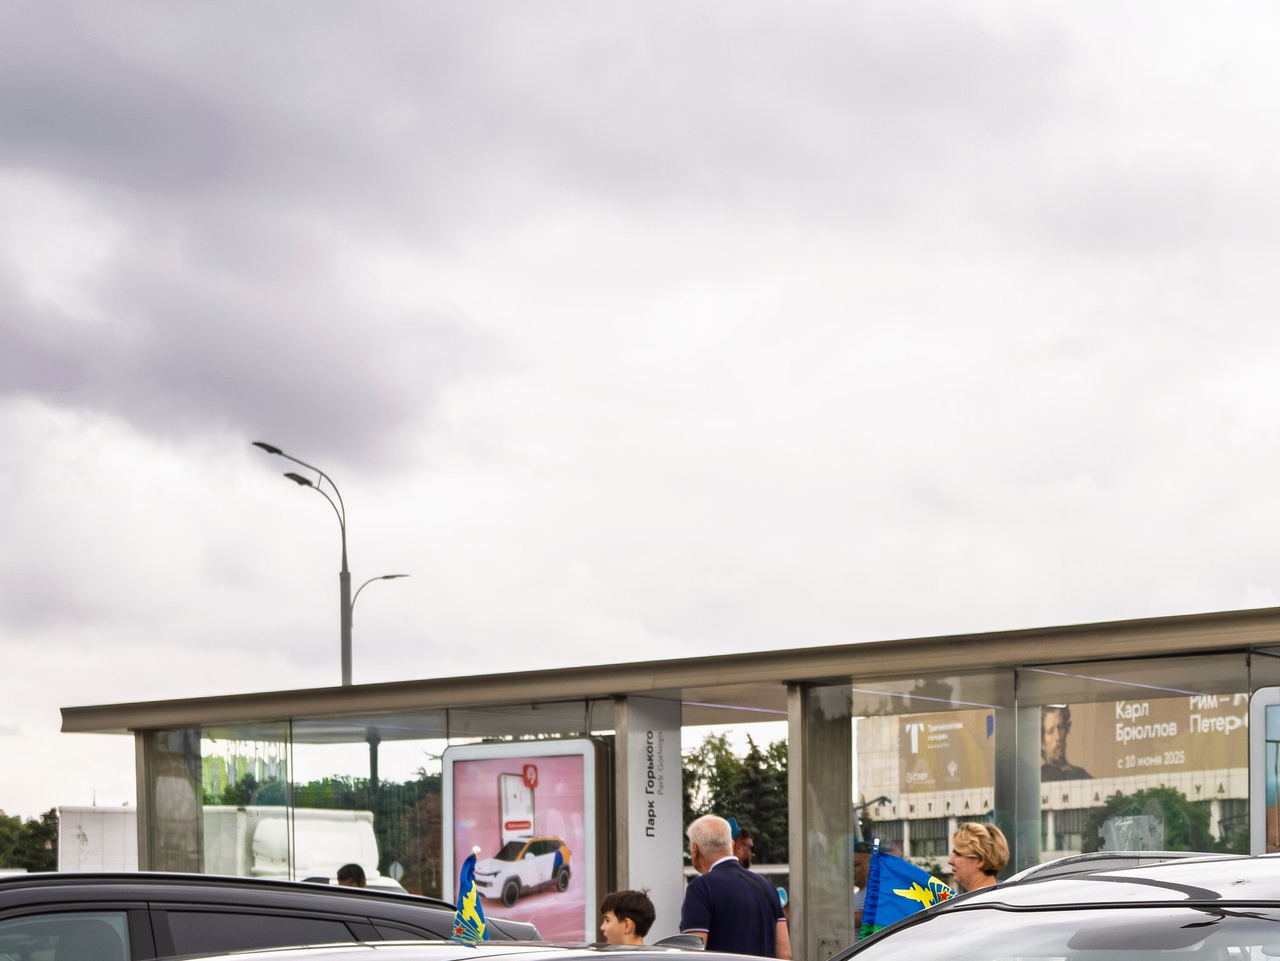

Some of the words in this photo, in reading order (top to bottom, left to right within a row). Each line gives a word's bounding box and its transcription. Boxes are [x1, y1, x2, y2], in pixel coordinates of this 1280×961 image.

[1115, 701, 1149, 722] Карл
[1115, 722, 1178, 745] Брюллов
[645, 730, 656, 795] Горького
[1125, 756, 1136, 768] 10
[1137, 755, 1162, 767] июня
[1164, 751, 1185, 765] 2025
[646, 800, 657, 837] Парк
